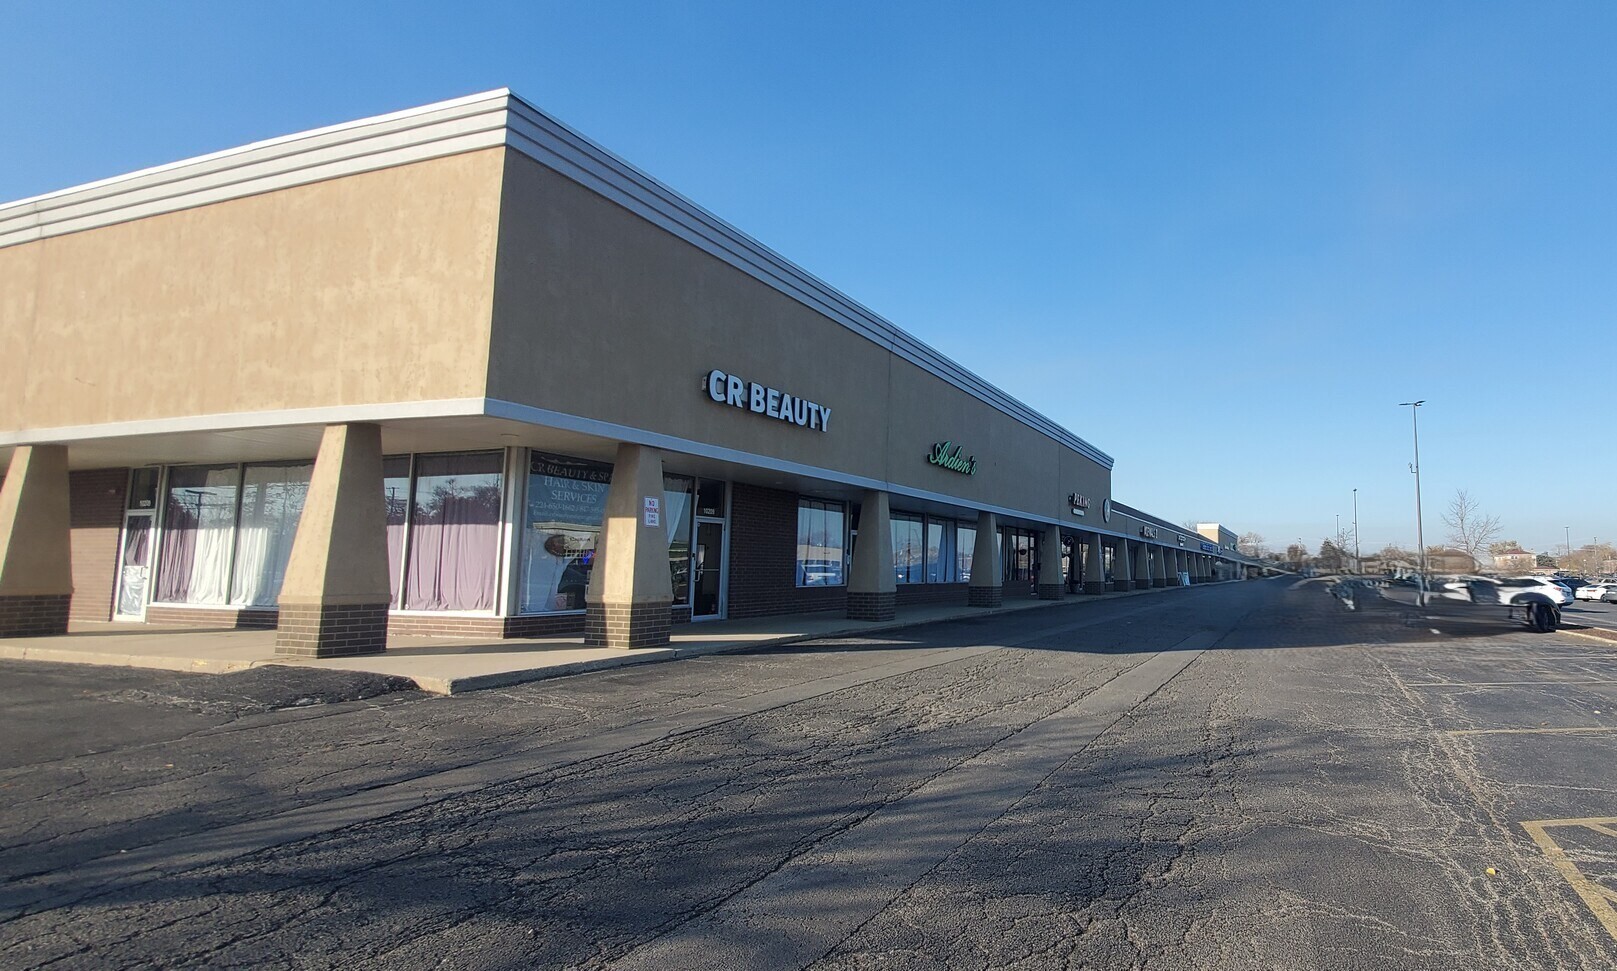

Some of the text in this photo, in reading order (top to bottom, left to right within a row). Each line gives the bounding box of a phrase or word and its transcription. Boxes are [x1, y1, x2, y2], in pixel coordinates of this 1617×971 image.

[707, 369, 832, 433] CR BEAUTY
[530, 461, 546, 473] CR
[547, 464, 588, 479] BEAUTY
[589, 471, 597, 481] &
[544, 475, 604, 493] HAIR & SKIN
[551, 490, 597, 504] SERVICES
[645, 506, 659, 514] PARKING
